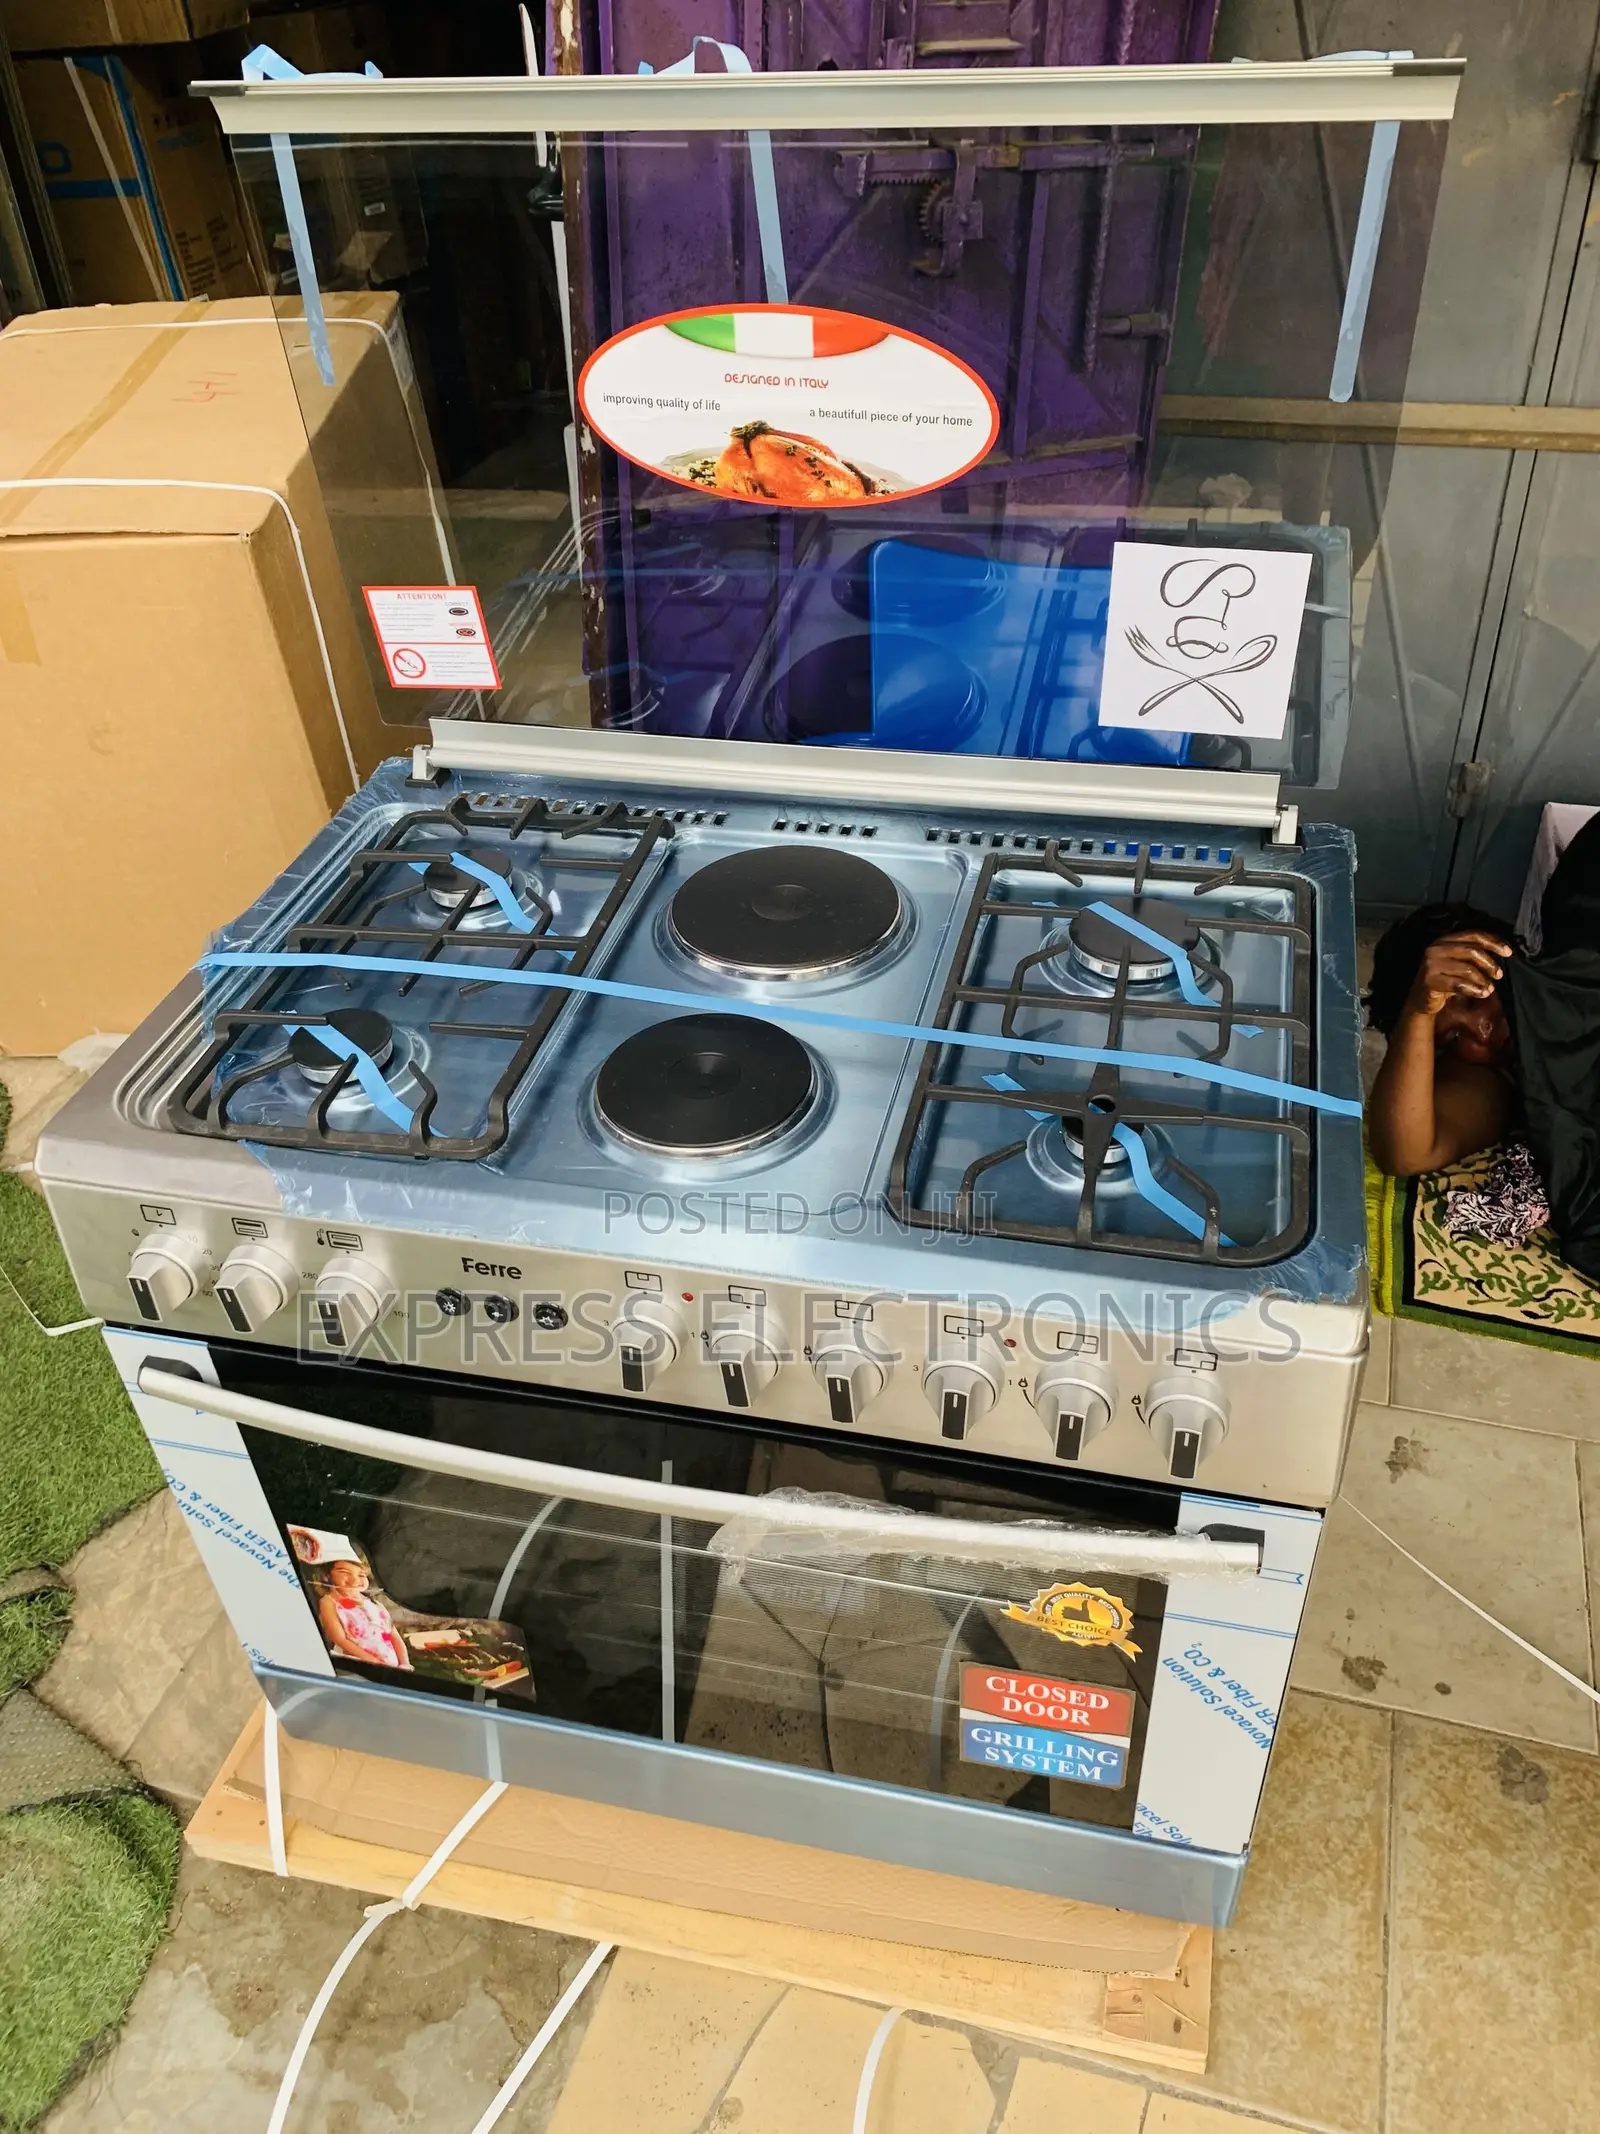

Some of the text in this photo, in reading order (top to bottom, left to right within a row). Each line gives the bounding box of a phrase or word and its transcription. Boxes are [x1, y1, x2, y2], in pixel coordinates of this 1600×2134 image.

[724, 373, 829, 389] DESIGNED IN ITALY
[603, 393, 721, 411] improving quality of life
[809, 407, 973, 427] a beautifull piece of your home
[461, 1257, 522, 1280] Ferre
[189, 1490, 202, 1502] &
[203, 1502, 244, 1531] Fiber
[214, 1527, 277, 1570] Novacel
[1036, 1615, 1113, 1637] BEST CHOICE
[1207, 1666, 1226, 1678] &
[986, 1675, 1110, 1711] CLOSED
[1161, 1657, 1273, 1749] Novacel Solution
[1220, 1679, 1263, 1709] Fiber
[1001, 1697, 1091, 1726] DOOR
[970, 1727, 1119, 1767] GRILLING
[984, 1748, 1103, 1781] SYSTEM
